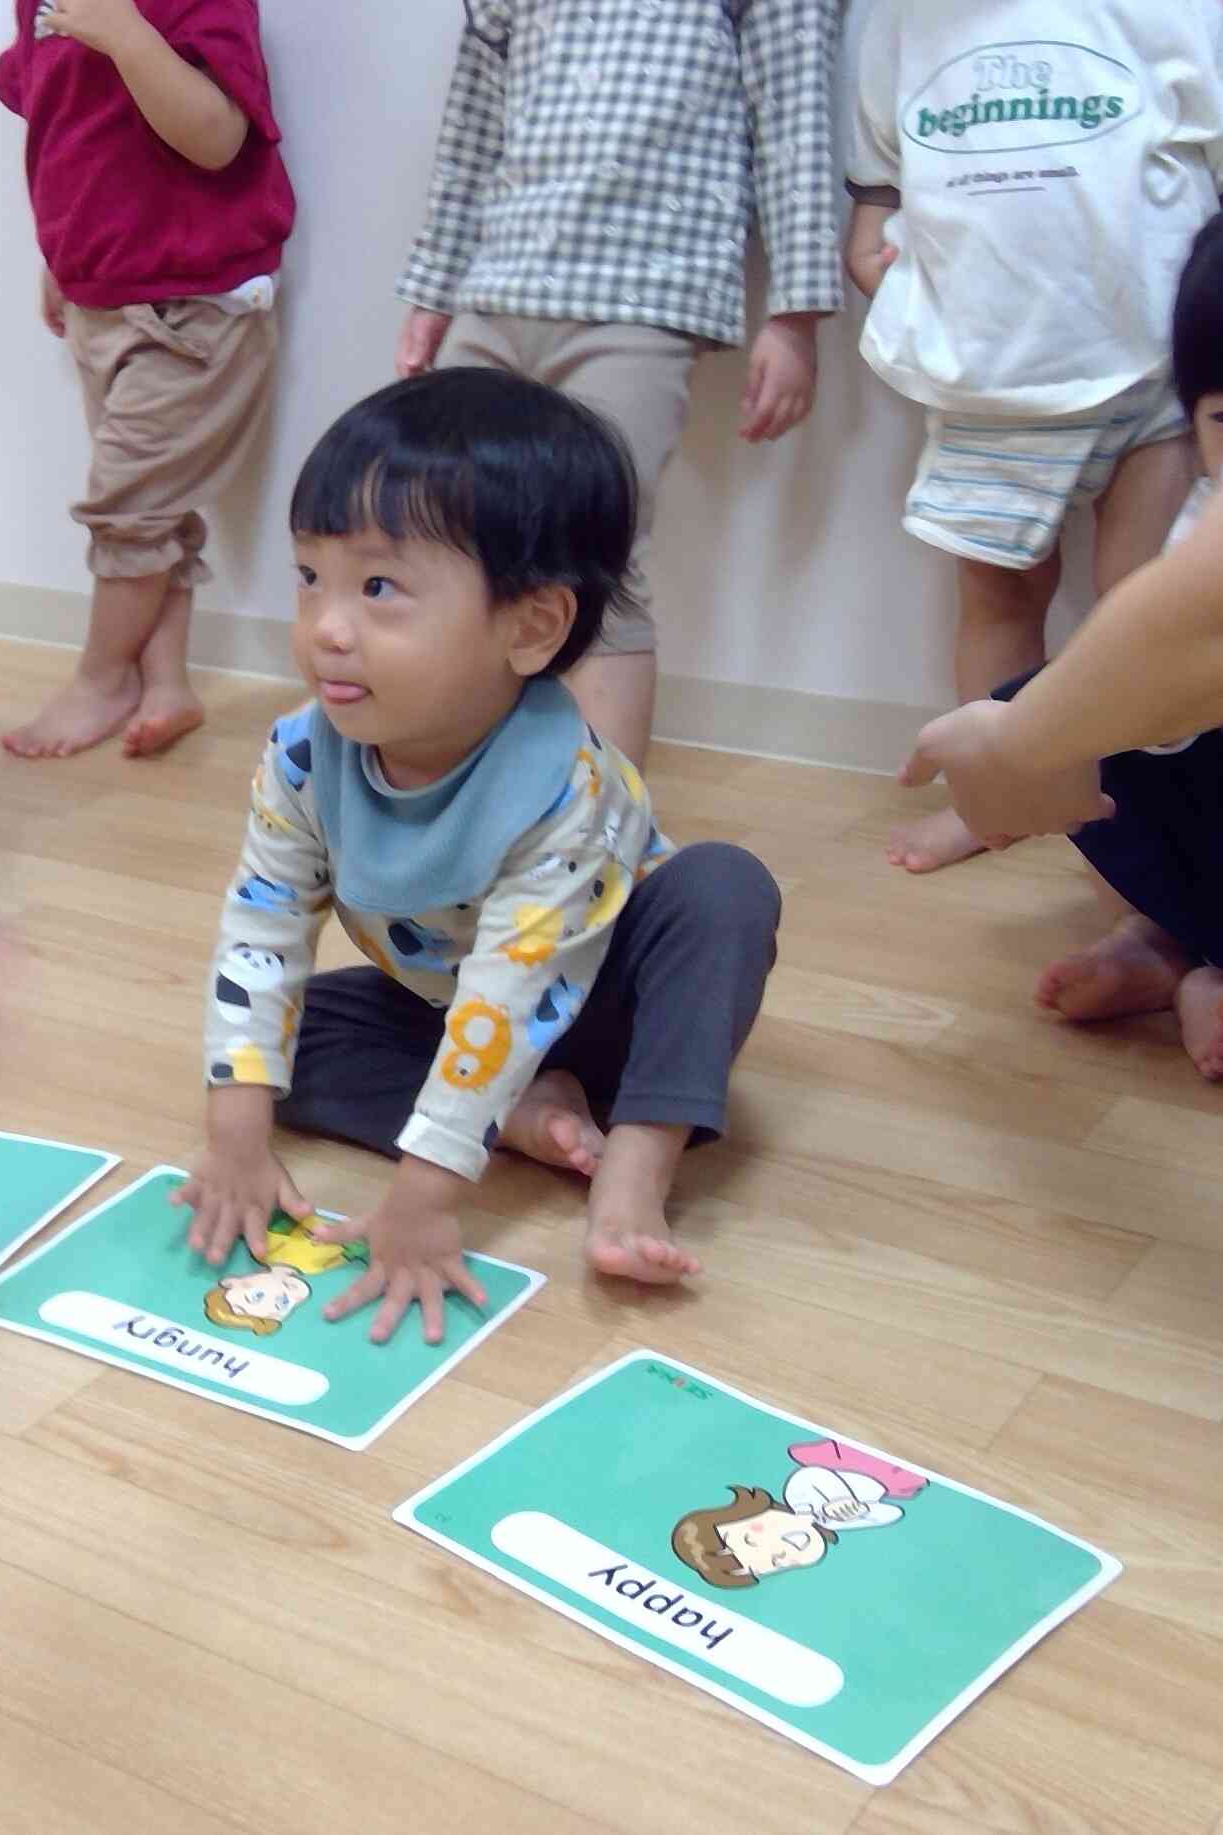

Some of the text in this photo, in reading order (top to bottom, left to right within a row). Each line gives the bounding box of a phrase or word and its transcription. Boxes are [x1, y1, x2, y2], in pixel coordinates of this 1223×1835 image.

[973, 53, 1053, 91] The
[917, 88, 1124, 138] beginnings
[112, 1315, 250, 1379] hungry
[588, 1564, 734, 1650] happy
